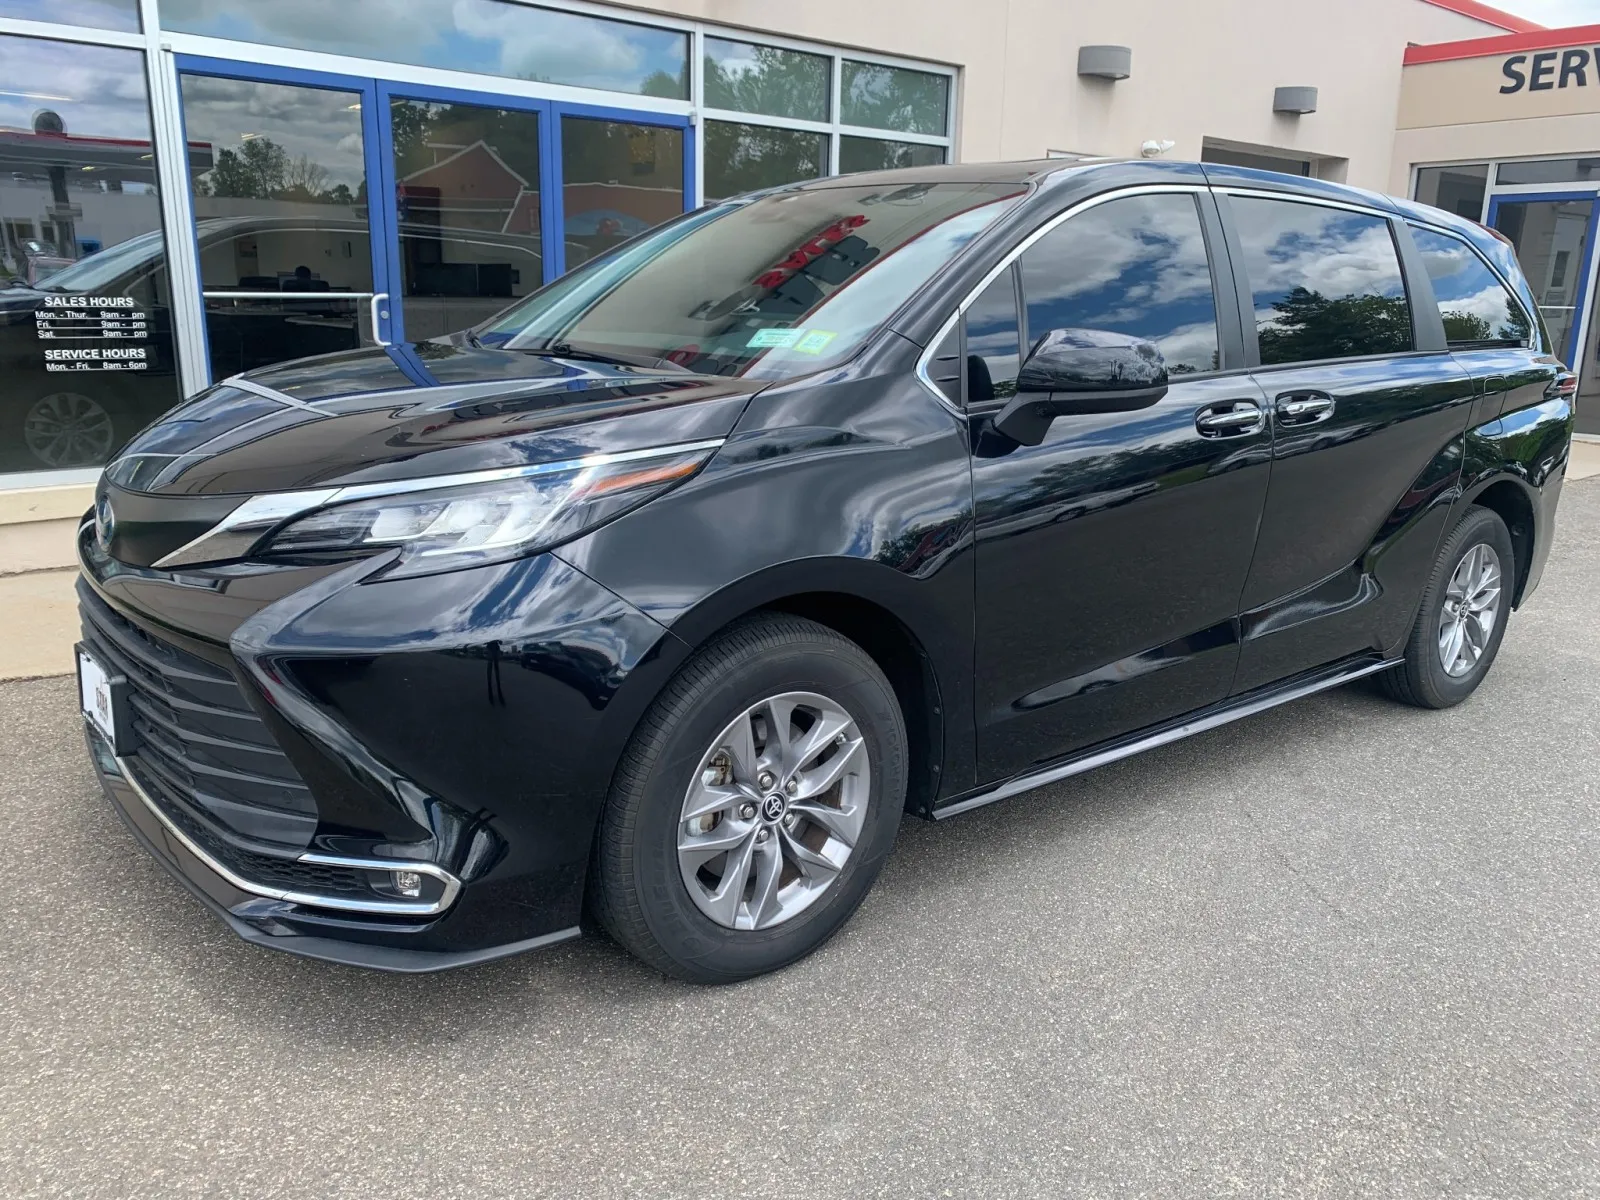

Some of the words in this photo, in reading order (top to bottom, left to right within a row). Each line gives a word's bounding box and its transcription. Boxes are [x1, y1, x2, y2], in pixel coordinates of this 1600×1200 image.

[1499, 47, 1600, 94] SER
[44, 297, 87, 307] SALES
[90, 297, 134, 307] HOURS
[35, 310, 58, 319] Mon.
[65, 310, 88, 319] Thur.
[100, 311, 119, 319] 9am
[36, 320, 51, 329] Fri.
[101, 320, 120, 329] 9am
[132, 321, 146, 329] pm
[37, 330, 56, 339] Sat.
[102, 330, 122, 338] 9am
[134, 331, 147, 339] pm
[44, 349, 99, 360] SERVICE
[102, 348, 146, 359] HOURS
[46, 363, 68, 371] Mon.
[76, 362, 90, 370] Fri.
[102, 361, 121, 370] 8am
[128, 361, 147, 369] 6pm
